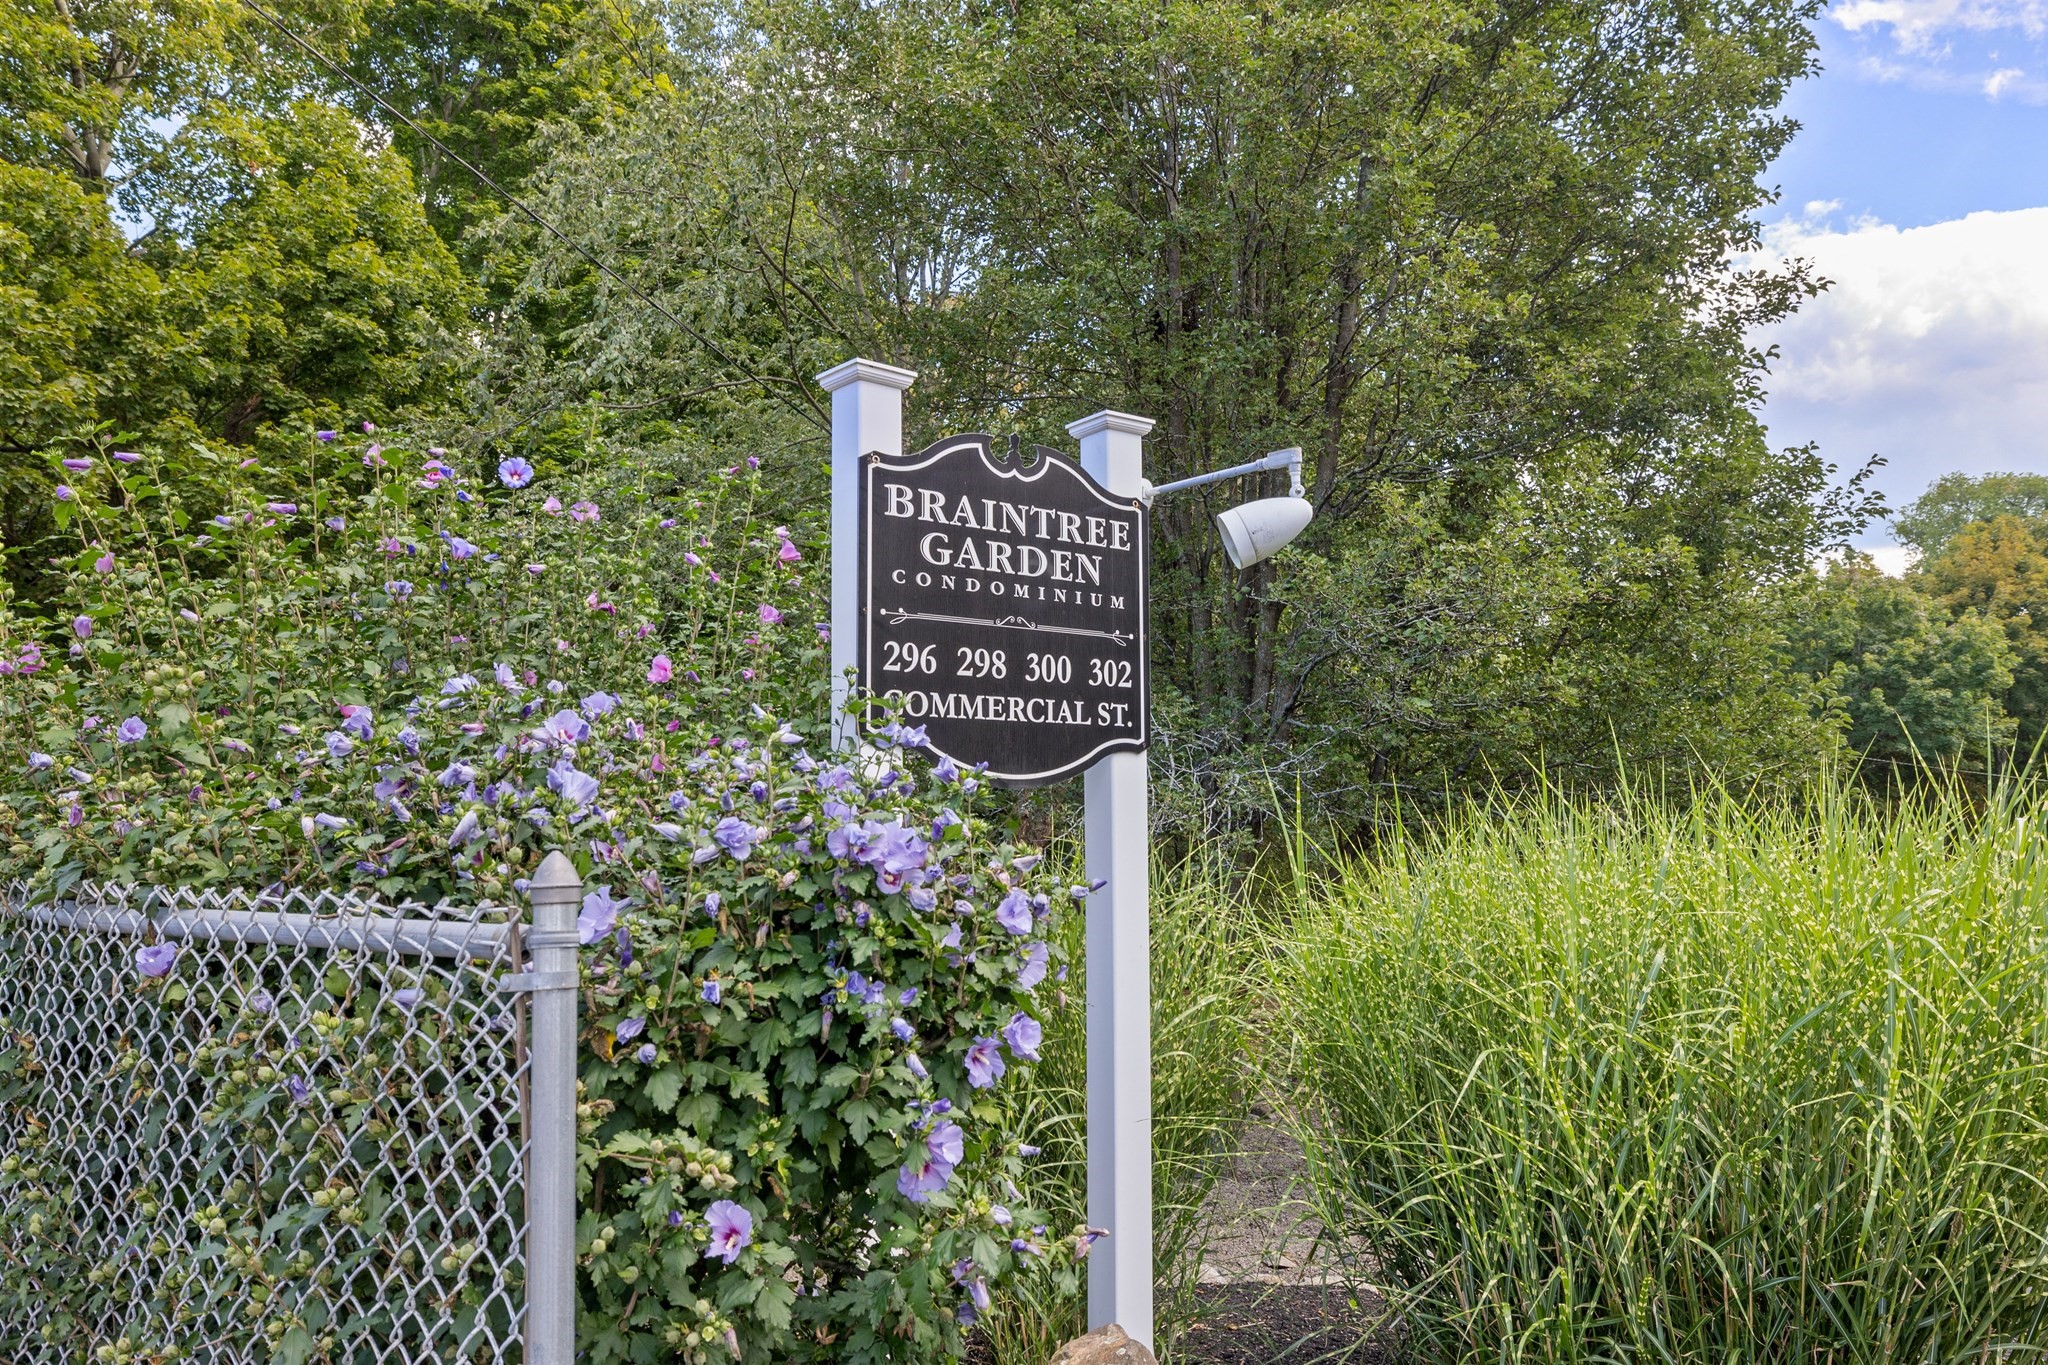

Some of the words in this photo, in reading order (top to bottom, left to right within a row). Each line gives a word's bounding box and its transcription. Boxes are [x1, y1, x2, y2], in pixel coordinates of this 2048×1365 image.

[883, 483, 1131, 551] BRAINTREE
[919, 532, 1102, 586] GARDEN
[891, 569, 1125, 609] CONDOMINIUM
[882, 640, 938, 675] 296
[956, 646, 1007, 679] 298
[1025, 652, 1072, 684] 300
[1088, 658, 1133, 689] 302
[1097, 702, 1133, 728] ST.
